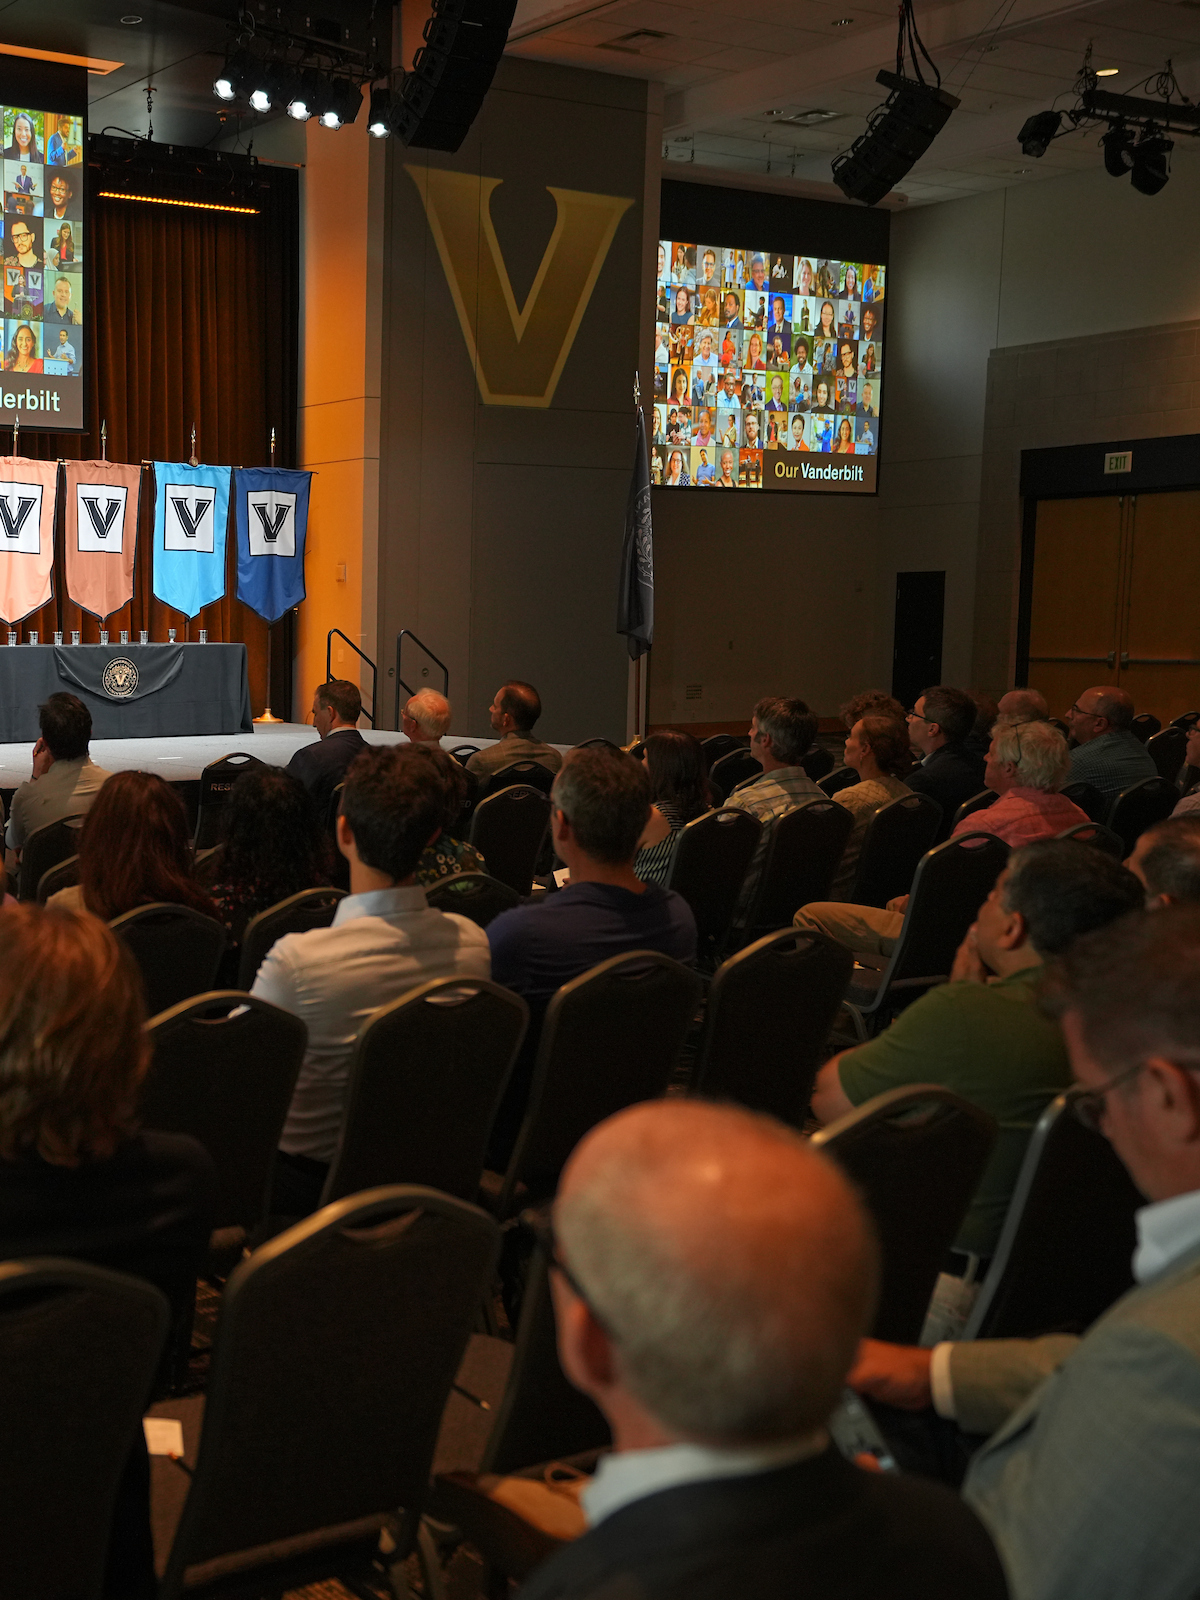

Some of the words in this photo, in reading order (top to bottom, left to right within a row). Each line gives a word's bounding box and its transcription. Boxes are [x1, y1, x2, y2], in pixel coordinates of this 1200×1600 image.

[403, 163, 636, 409] V
[774, 461, 799, 478] Our
[801, 462, 864, 482] Vanderbilt
[1109, 455, 1127, 471] EXIT
[80, 496, 123, 539] V
[170, 497, 213, 538] V
[252, 503, 292, 543] V
